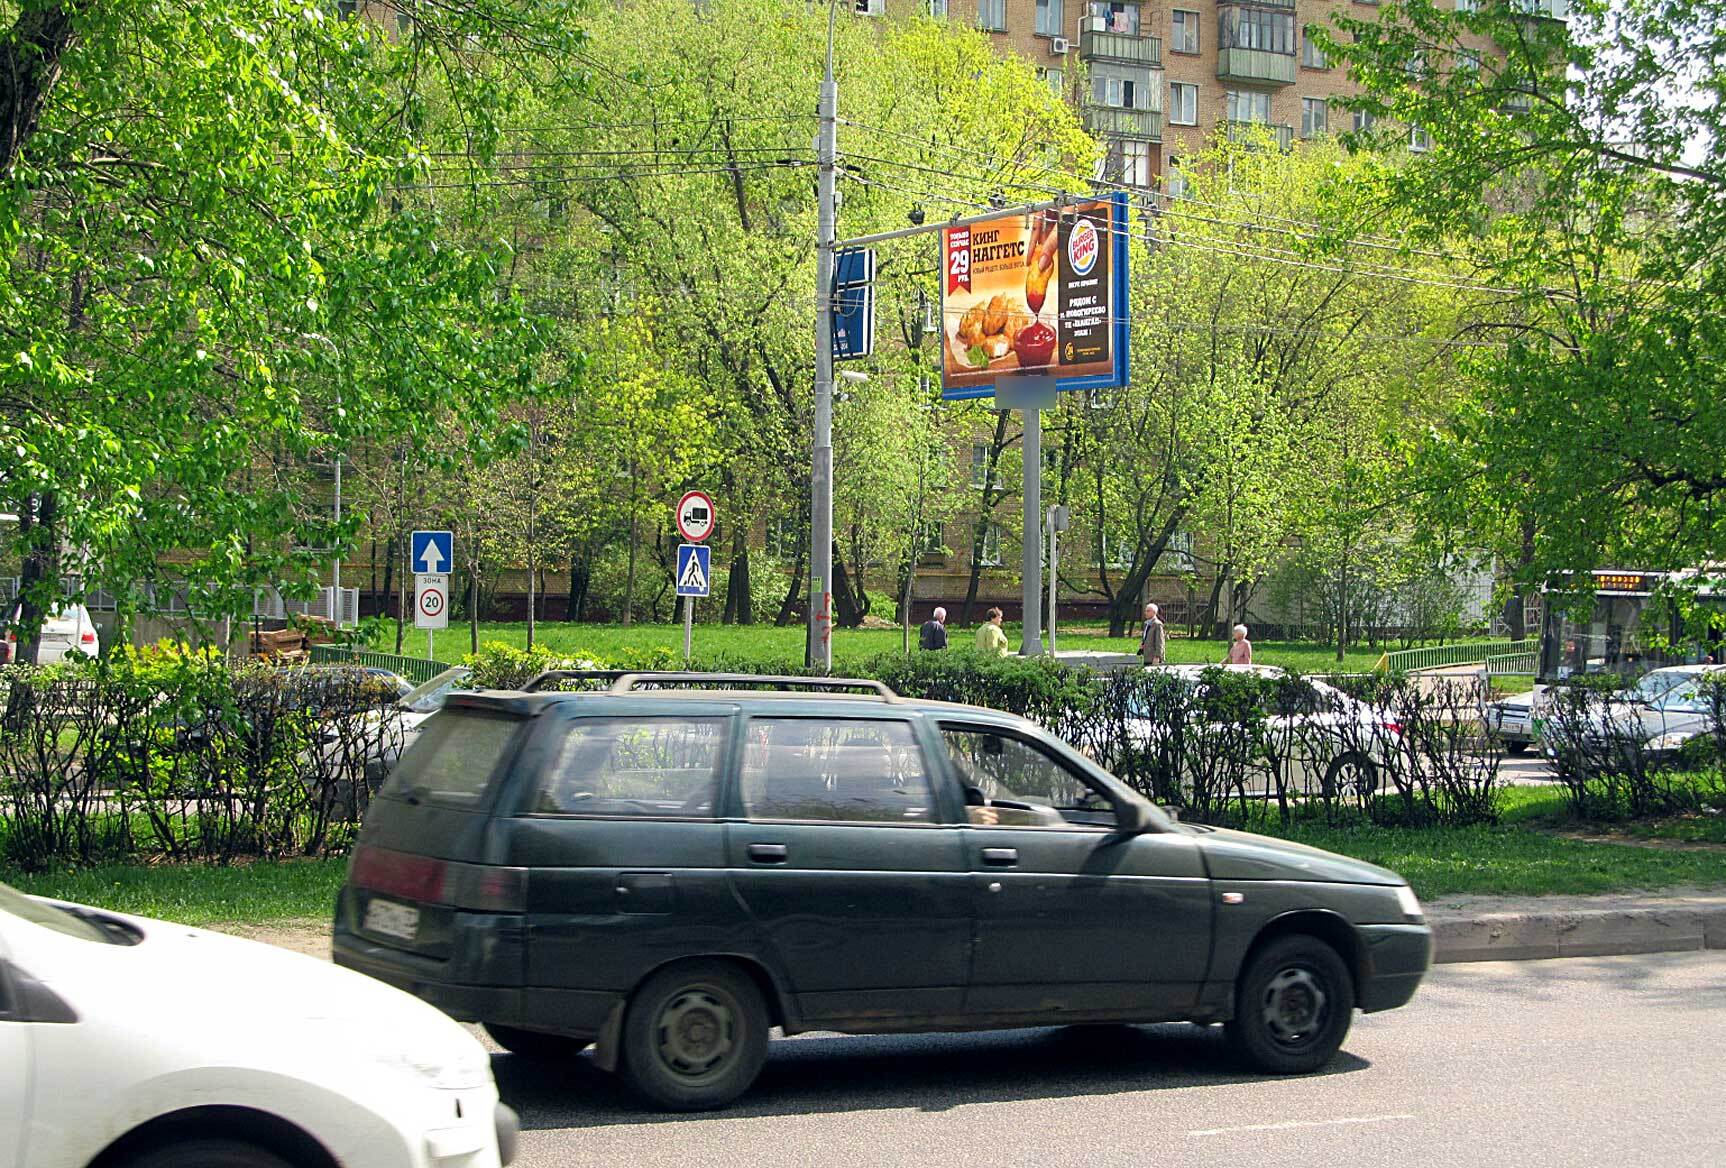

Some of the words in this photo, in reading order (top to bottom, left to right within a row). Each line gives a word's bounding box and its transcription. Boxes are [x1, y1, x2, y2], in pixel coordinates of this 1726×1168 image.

[973, 230, 1000, 246] КИНГ
[1073, 228, 1094, 250] BURGER
[950, 250, 970, 274] 29
[973, 241, 1025, 263] НАГГЕТС
[1073, 240, 1095, 262] KING
[1069, 296, 1091, 308] РЯДОМ
[425, 596, 439, 608] 20
